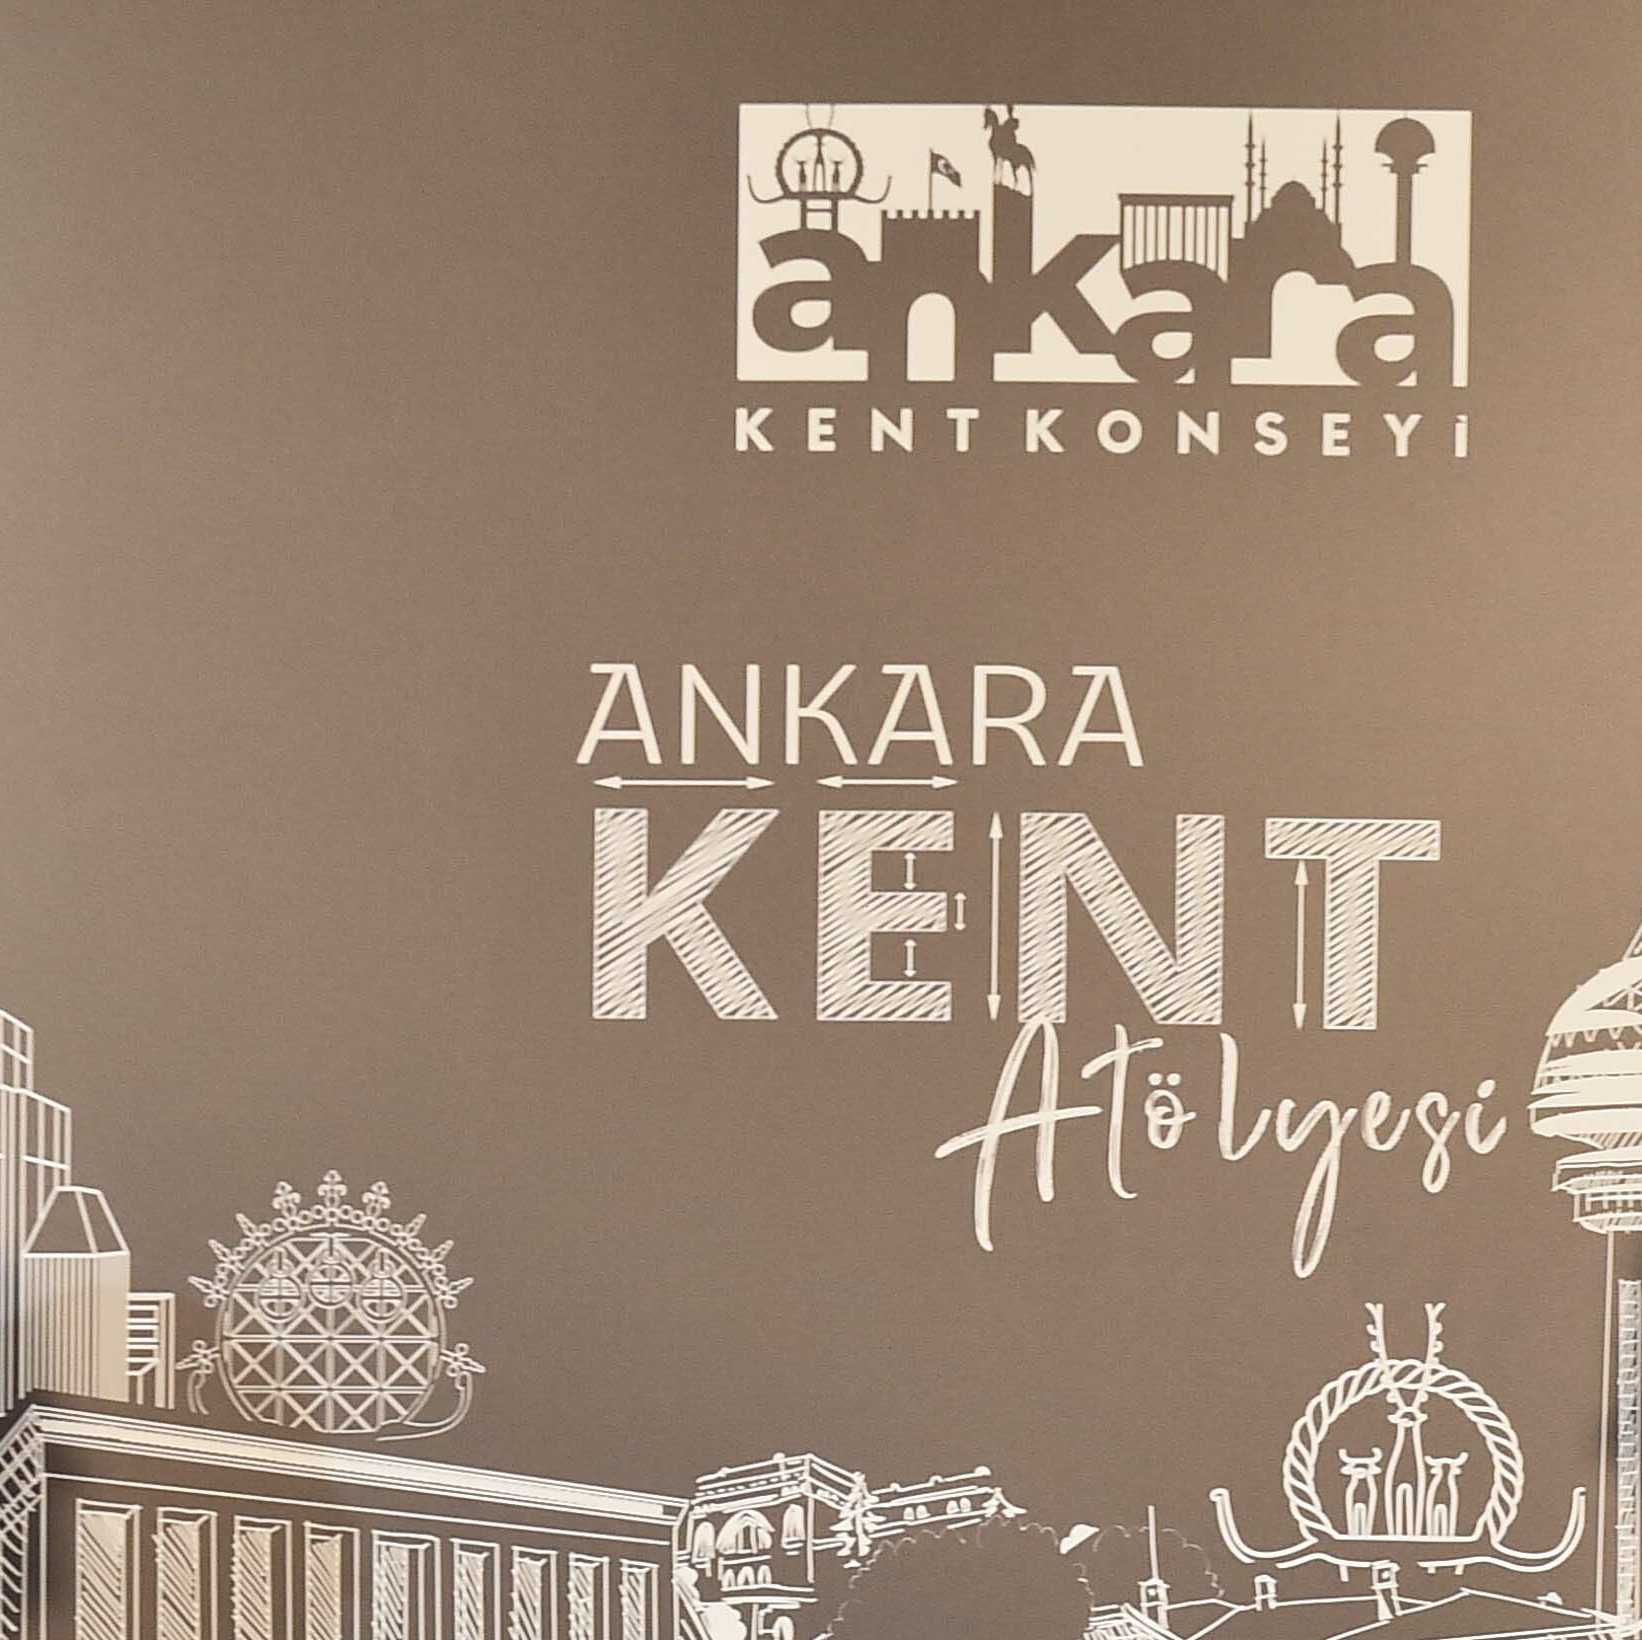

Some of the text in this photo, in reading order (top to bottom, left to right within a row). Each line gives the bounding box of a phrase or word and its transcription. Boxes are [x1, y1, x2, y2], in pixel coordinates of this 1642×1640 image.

[752, 190, 1455, 386] ankara
[734, 407, 980, 453] KENT
[575, 663, 1145, 768] ANKARA
[591, 807, 1442, 1031] KENT
